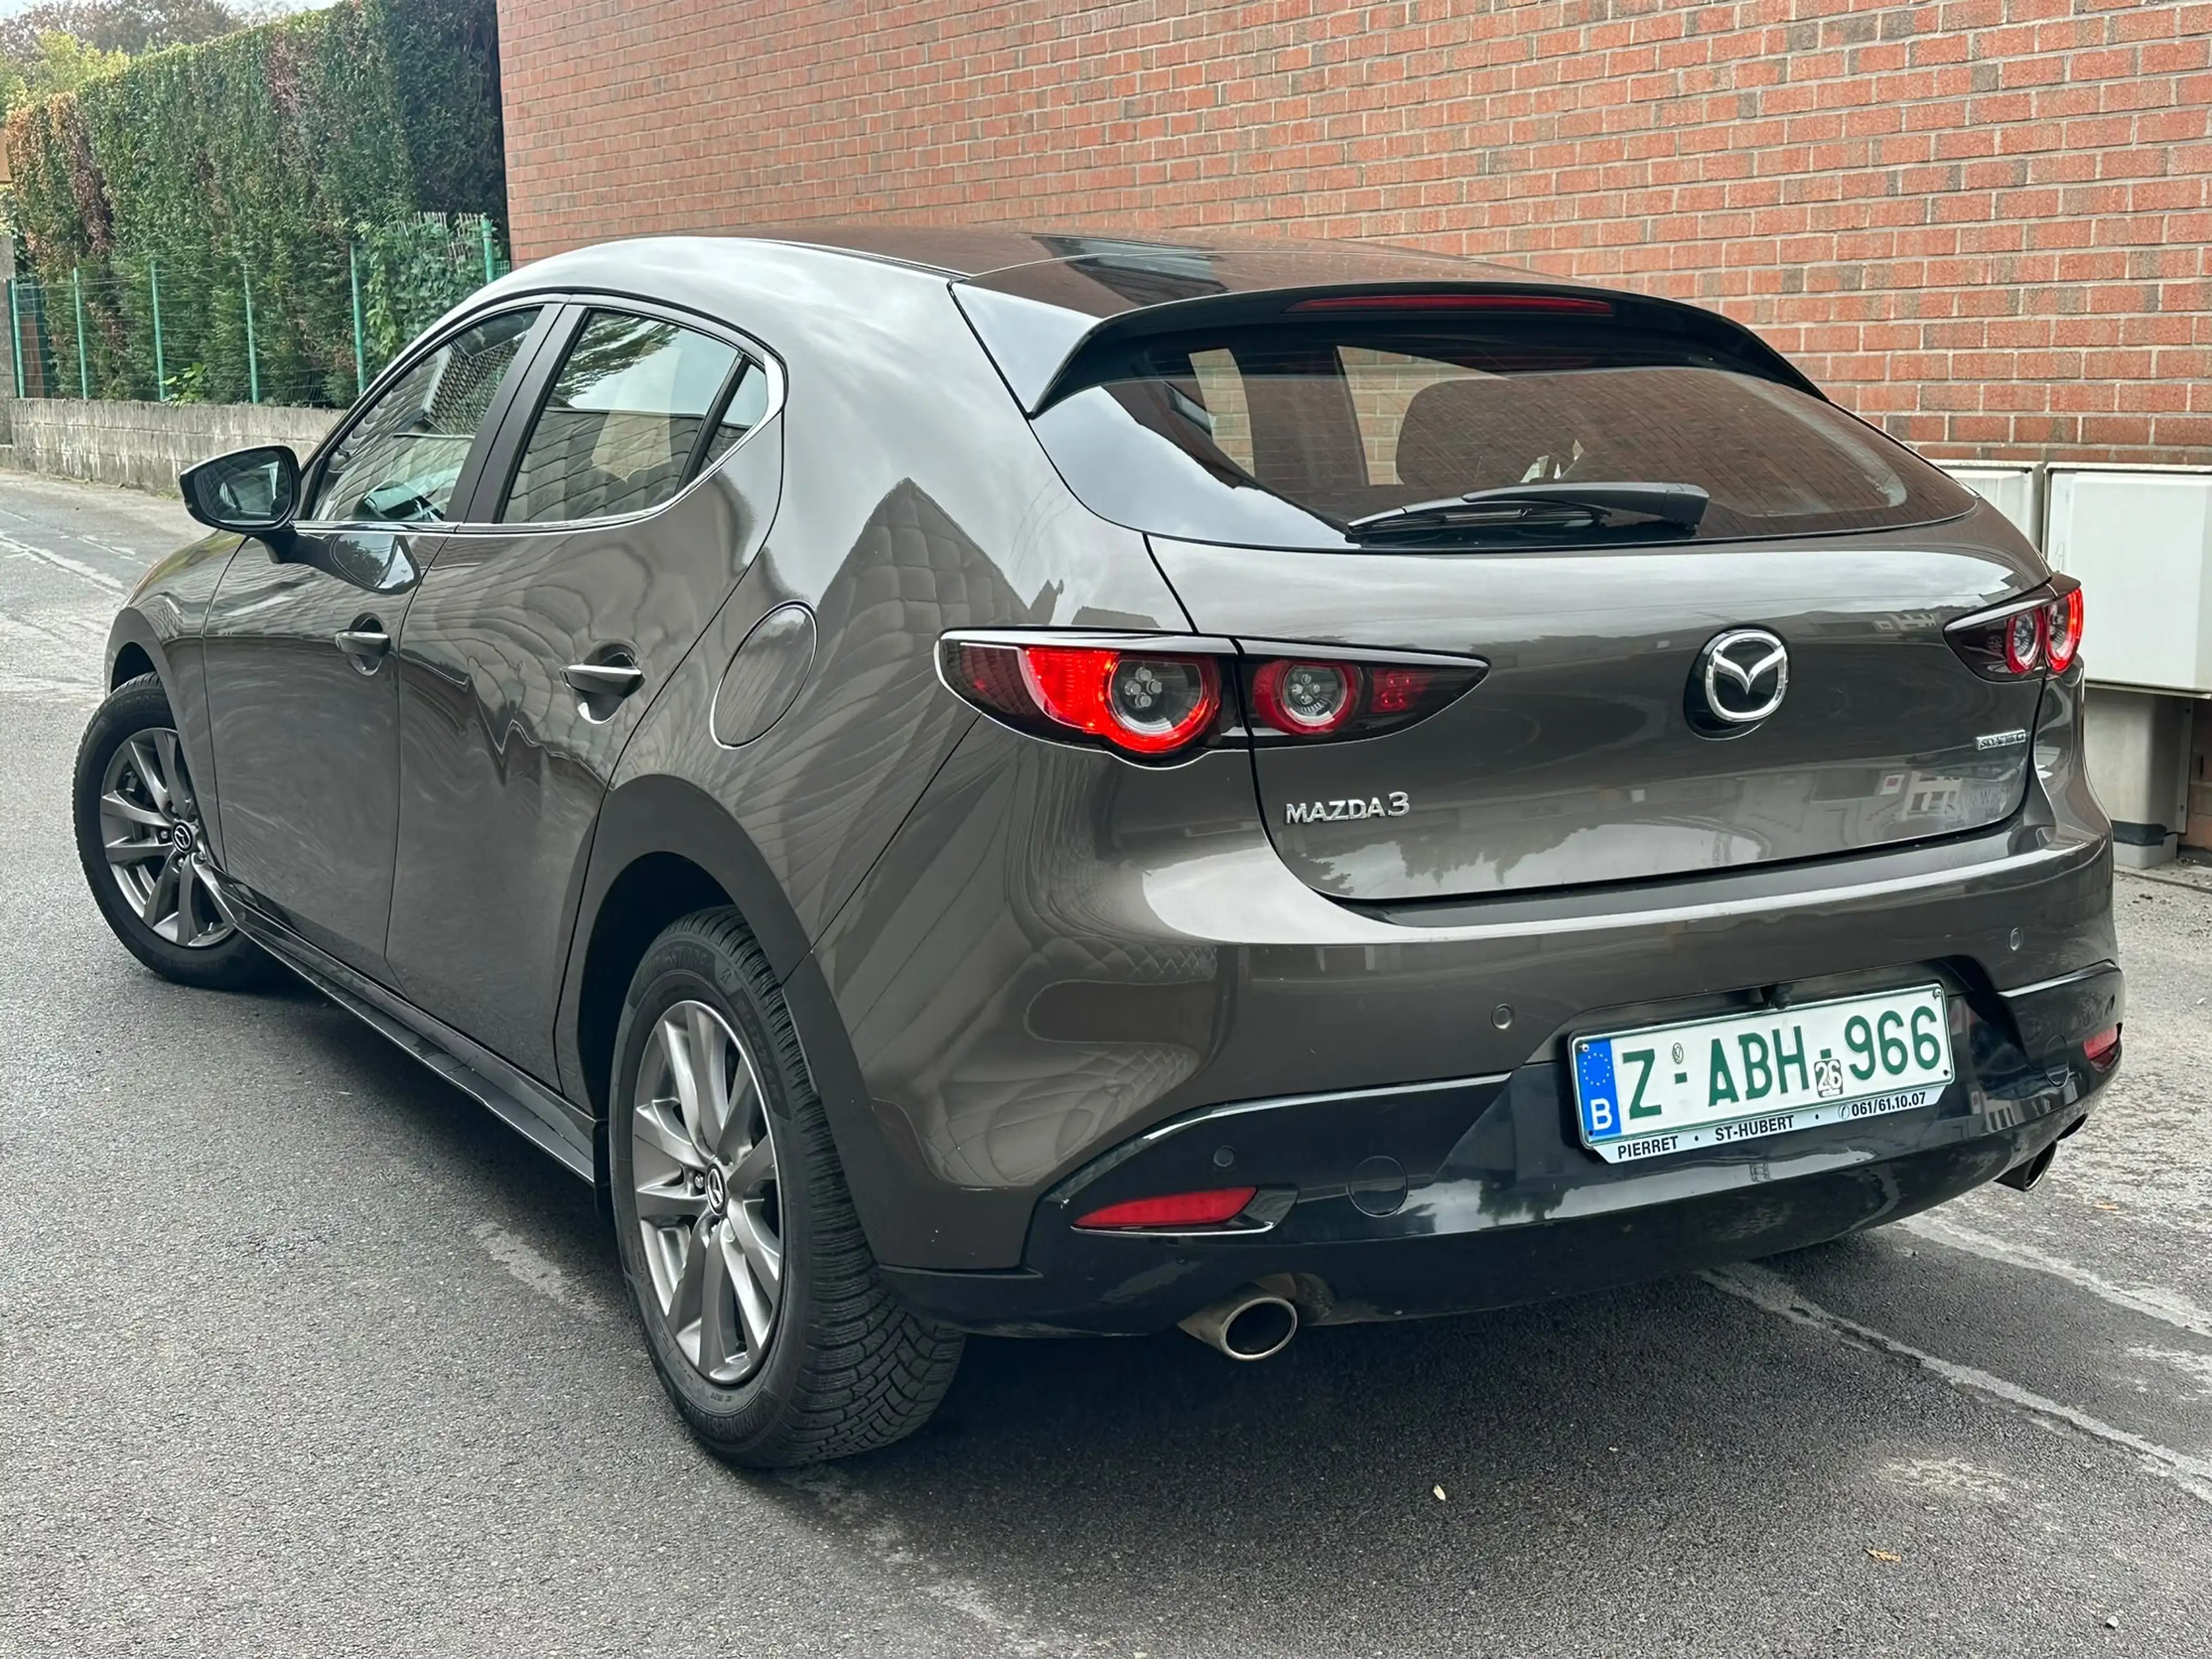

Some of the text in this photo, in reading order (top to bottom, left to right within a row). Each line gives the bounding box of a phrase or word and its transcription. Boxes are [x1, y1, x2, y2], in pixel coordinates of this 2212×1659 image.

[1590, 1098, 1612, 1130] B
[1618, 1091, 1926, 1160] PIERRET ST-HUBERT 061/61.10.07
